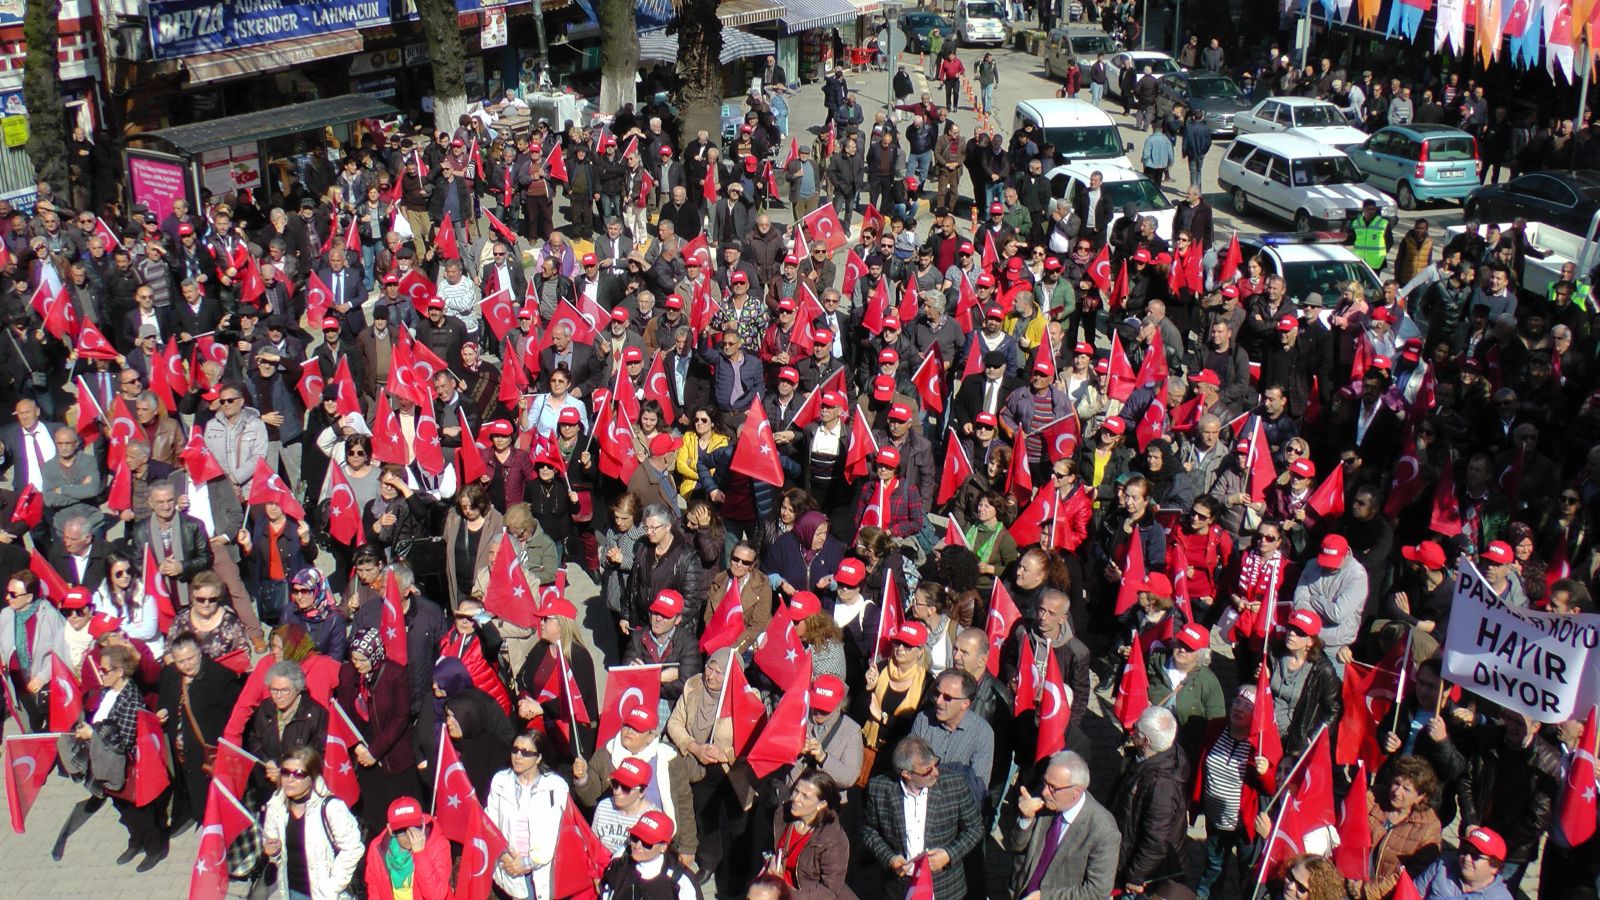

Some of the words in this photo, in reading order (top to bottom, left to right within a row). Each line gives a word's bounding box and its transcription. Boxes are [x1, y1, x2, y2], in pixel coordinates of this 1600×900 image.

[159, 3, 225, 44] BEYZA
[233, 14, 298, 39] İSKENDER
[312, 2, 379, 26] LAHMACUN
[1476, 617, 1568, 684] HAYIR
[1473, 661, 1561, 714] DİYOR
